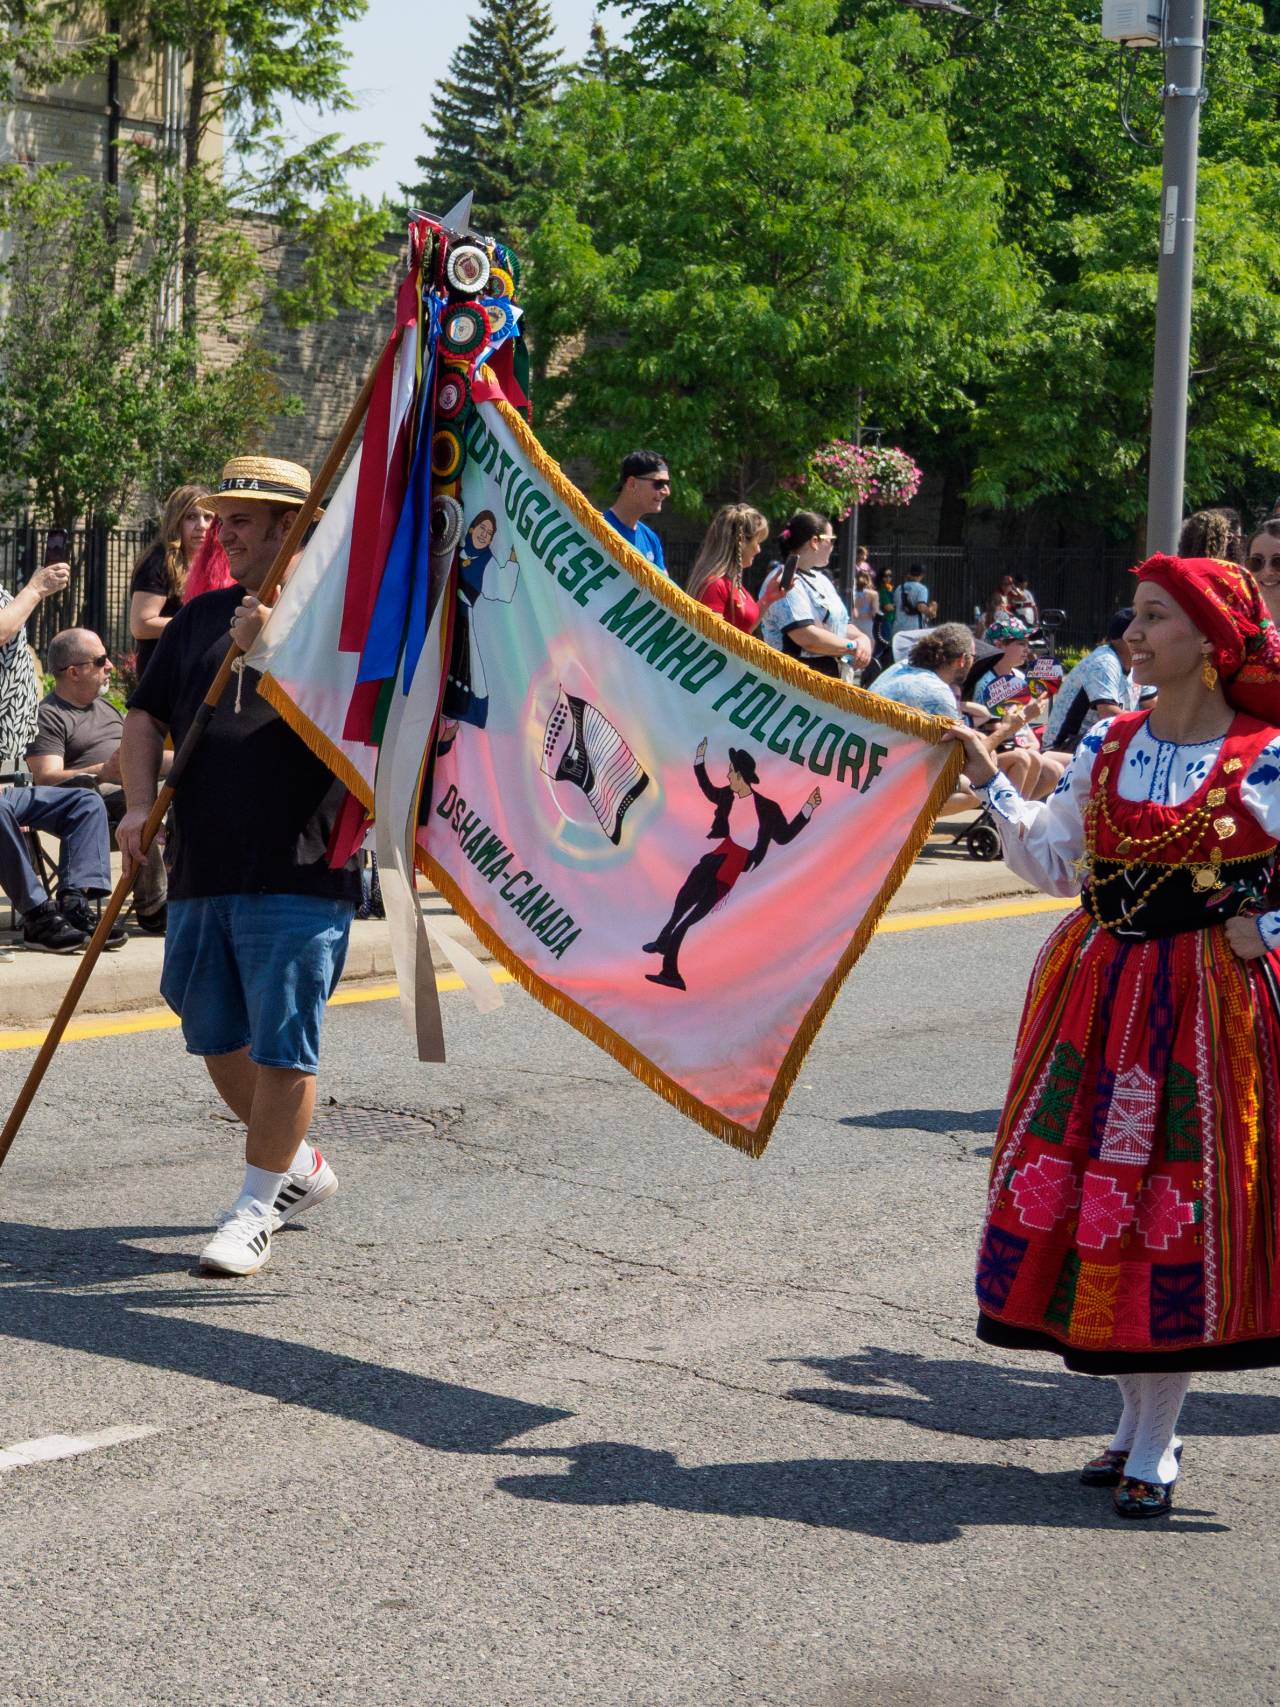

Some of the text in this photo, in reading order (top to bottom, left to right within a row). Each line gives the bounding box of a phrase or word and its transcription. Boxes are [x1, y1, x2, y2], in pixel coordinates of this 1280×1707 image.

[219, 479, 259, 490] EIRA
[468, 411, 620, 608] ORTUGUESE
[600, 587, 728, 694] MINHO
[989, 678, 1005, 690] FELIZ
[991, 682, 1011, 697] DIA DE
[436, 784, 583, 960] OSHAWA-CANADA
